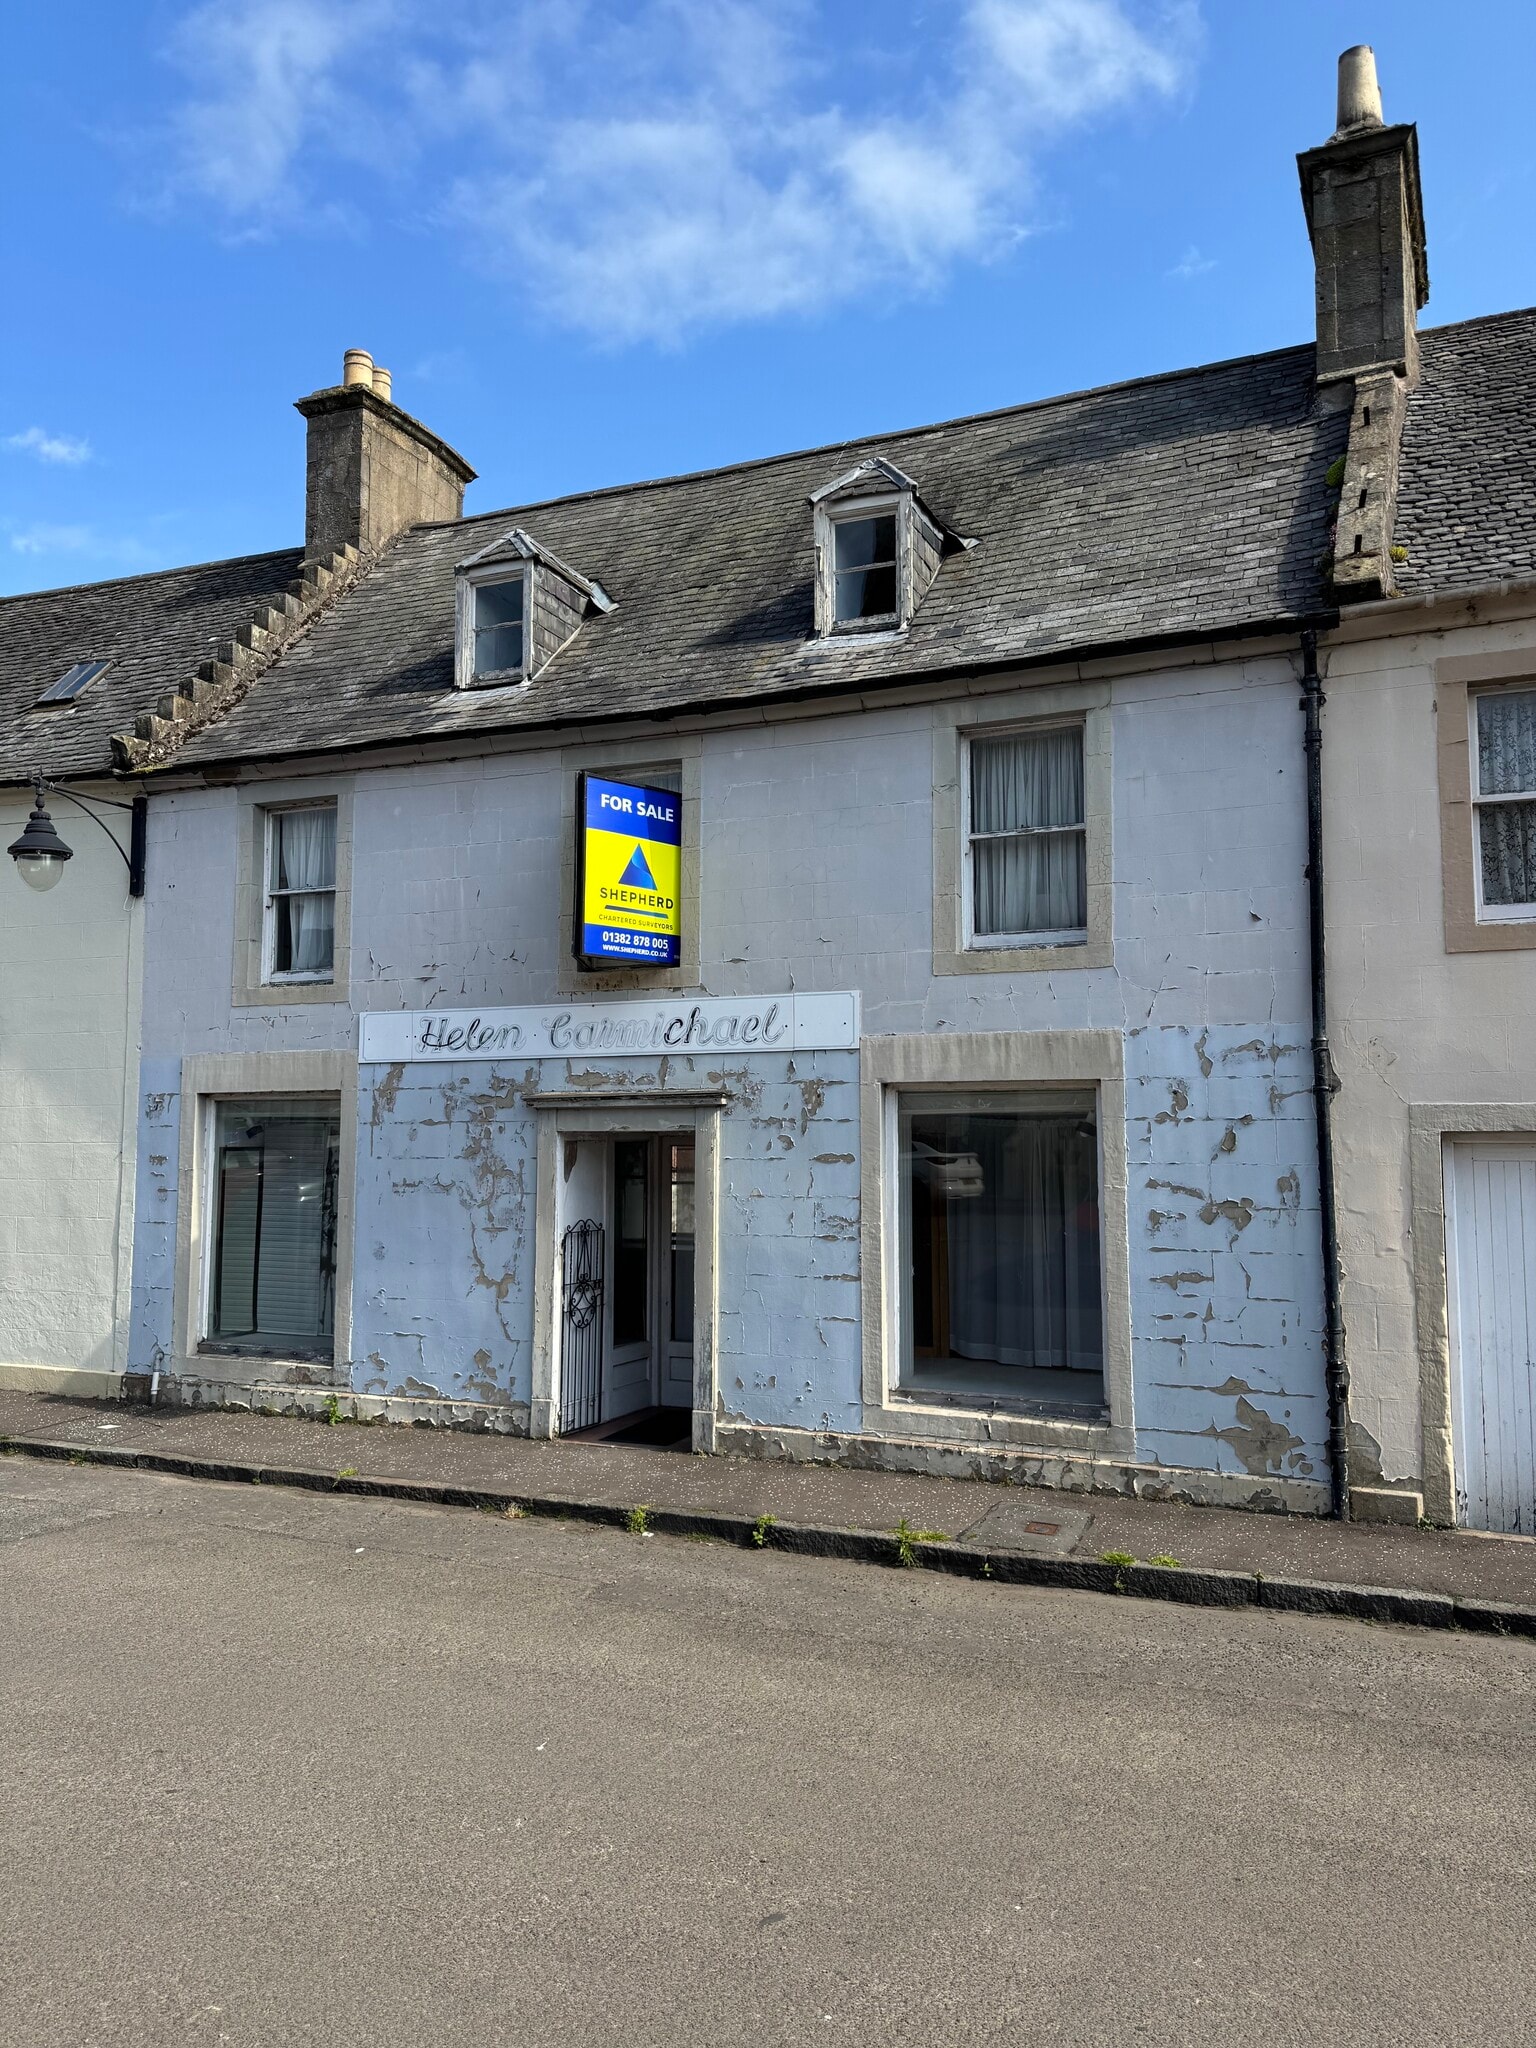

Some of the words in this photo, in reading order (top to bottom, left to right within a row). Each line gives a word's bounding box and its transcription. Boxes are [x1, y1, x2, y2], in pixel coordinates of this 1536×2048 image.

[600, 793, 633, 814] FOR
[636, 801, 674, 823] SALE
[600, 887, 674, 910] SHEPHERD
[598, 914, 637, 925] CHARTERED
[638, 920, 674, 931] SURVEYORS
[602, 931, 631, 945] 01382
[633, 935, 650, 947] 878
[652, 937, 669, 949] 005
[602, 944, 668, 958] WWW.SHEPHERD.CO.UK
[416, 1015, 526, 1054] Helen
[541, 1002, 786, 1049] Carmichael
